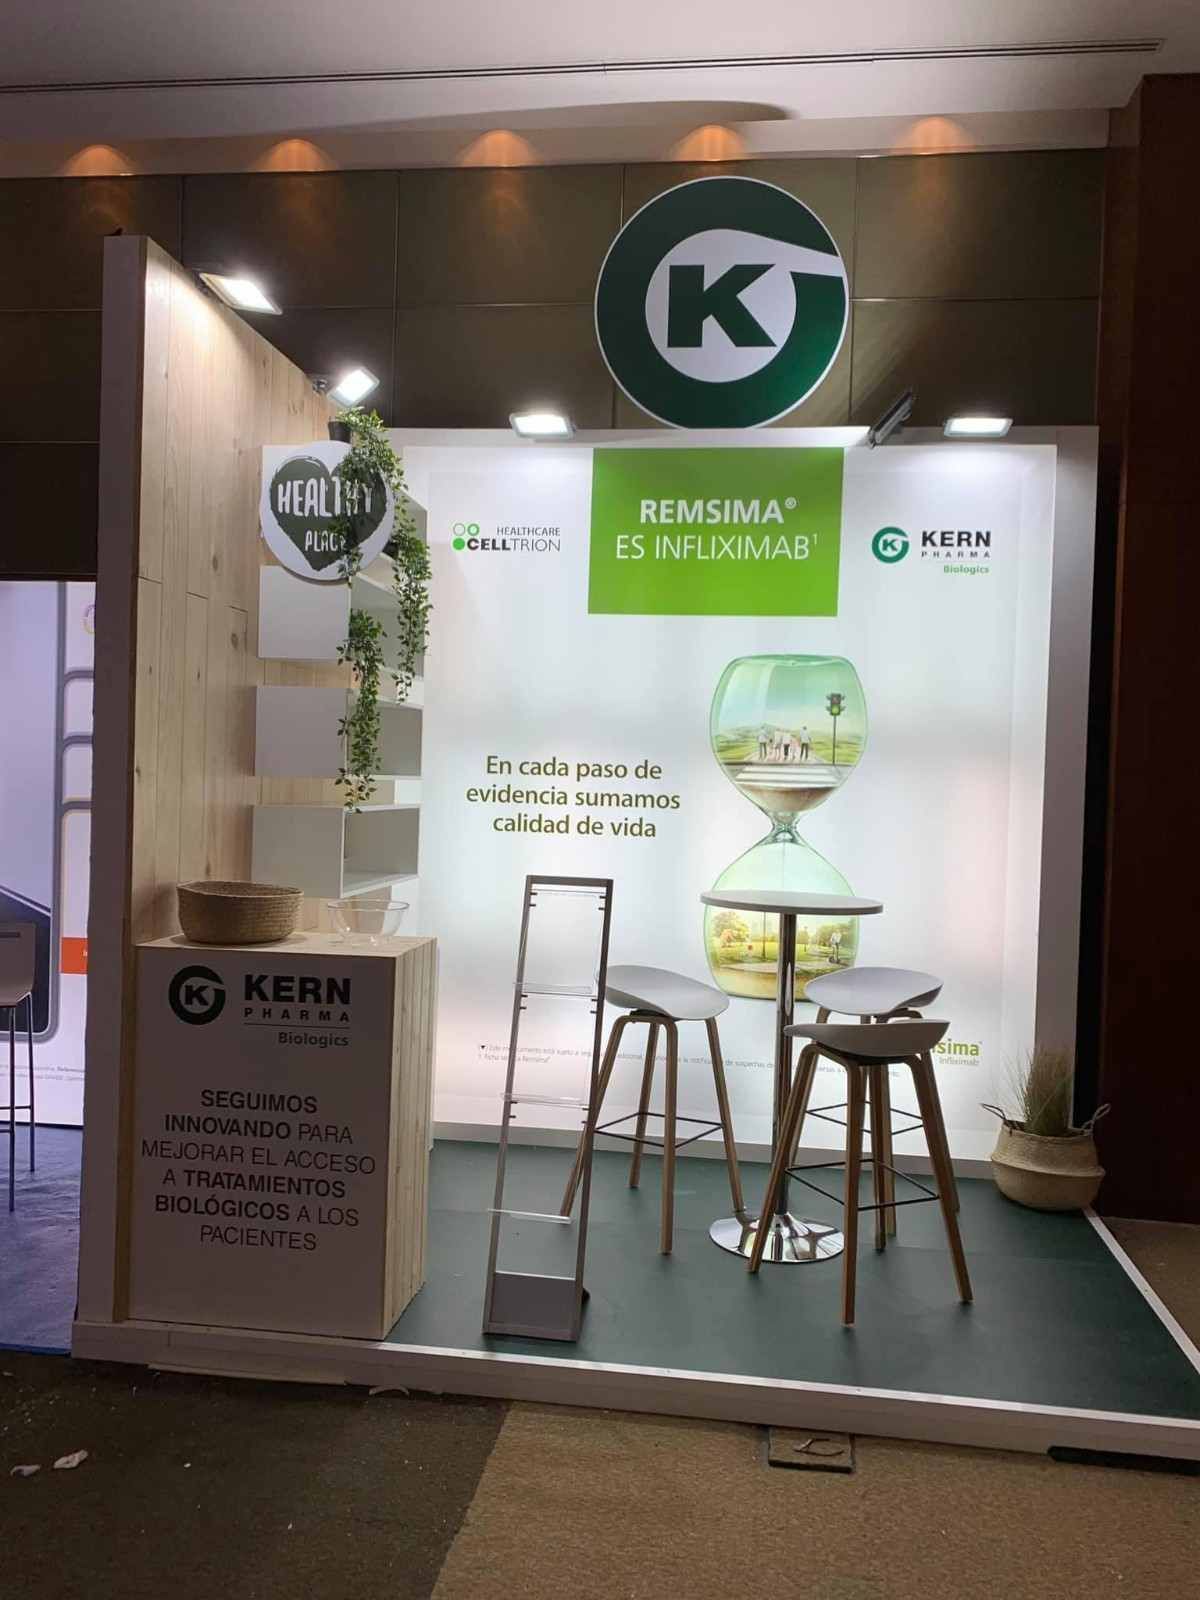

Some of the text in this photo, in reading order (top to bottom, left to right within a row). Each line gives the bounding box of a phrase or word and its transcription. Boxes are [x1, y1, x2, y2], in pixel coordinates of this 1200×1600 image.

[496, 526, 560, 537] HEALTHCARE
[921, 530, 991, 548] KERN
[467, 538, 560, 552] CELLTRION
[616, 534, 645, 560] ES
[921, 551, 990, 559] PHARMA
[943, 565, 990, 575] Biologics
[487, 755, 663, 782] En cada paso de
[466, 784, 681, 810] evidencia sumamos
[493, 813, 656, 838] calidad de vida
[244, 974, 351, 1005] KERN
[244, 1007, 350, 1023] PHARMA
[278, 1031, 349, 1049] Biologics
[201, 1089, 317, 1114] SEGUIMOS
[165, 1114, 353, 1145] INNOVANDO PARA
[141, 1139, 376, 1175] MEJORAR EL ACCESO
[162, 1168, 345, 1199] A TRATAMIENTOS
[155, 1194, 359, 1227] BIOLÓGICOS A LOS
[200, 1224, 317, 1251] PACIENTES
